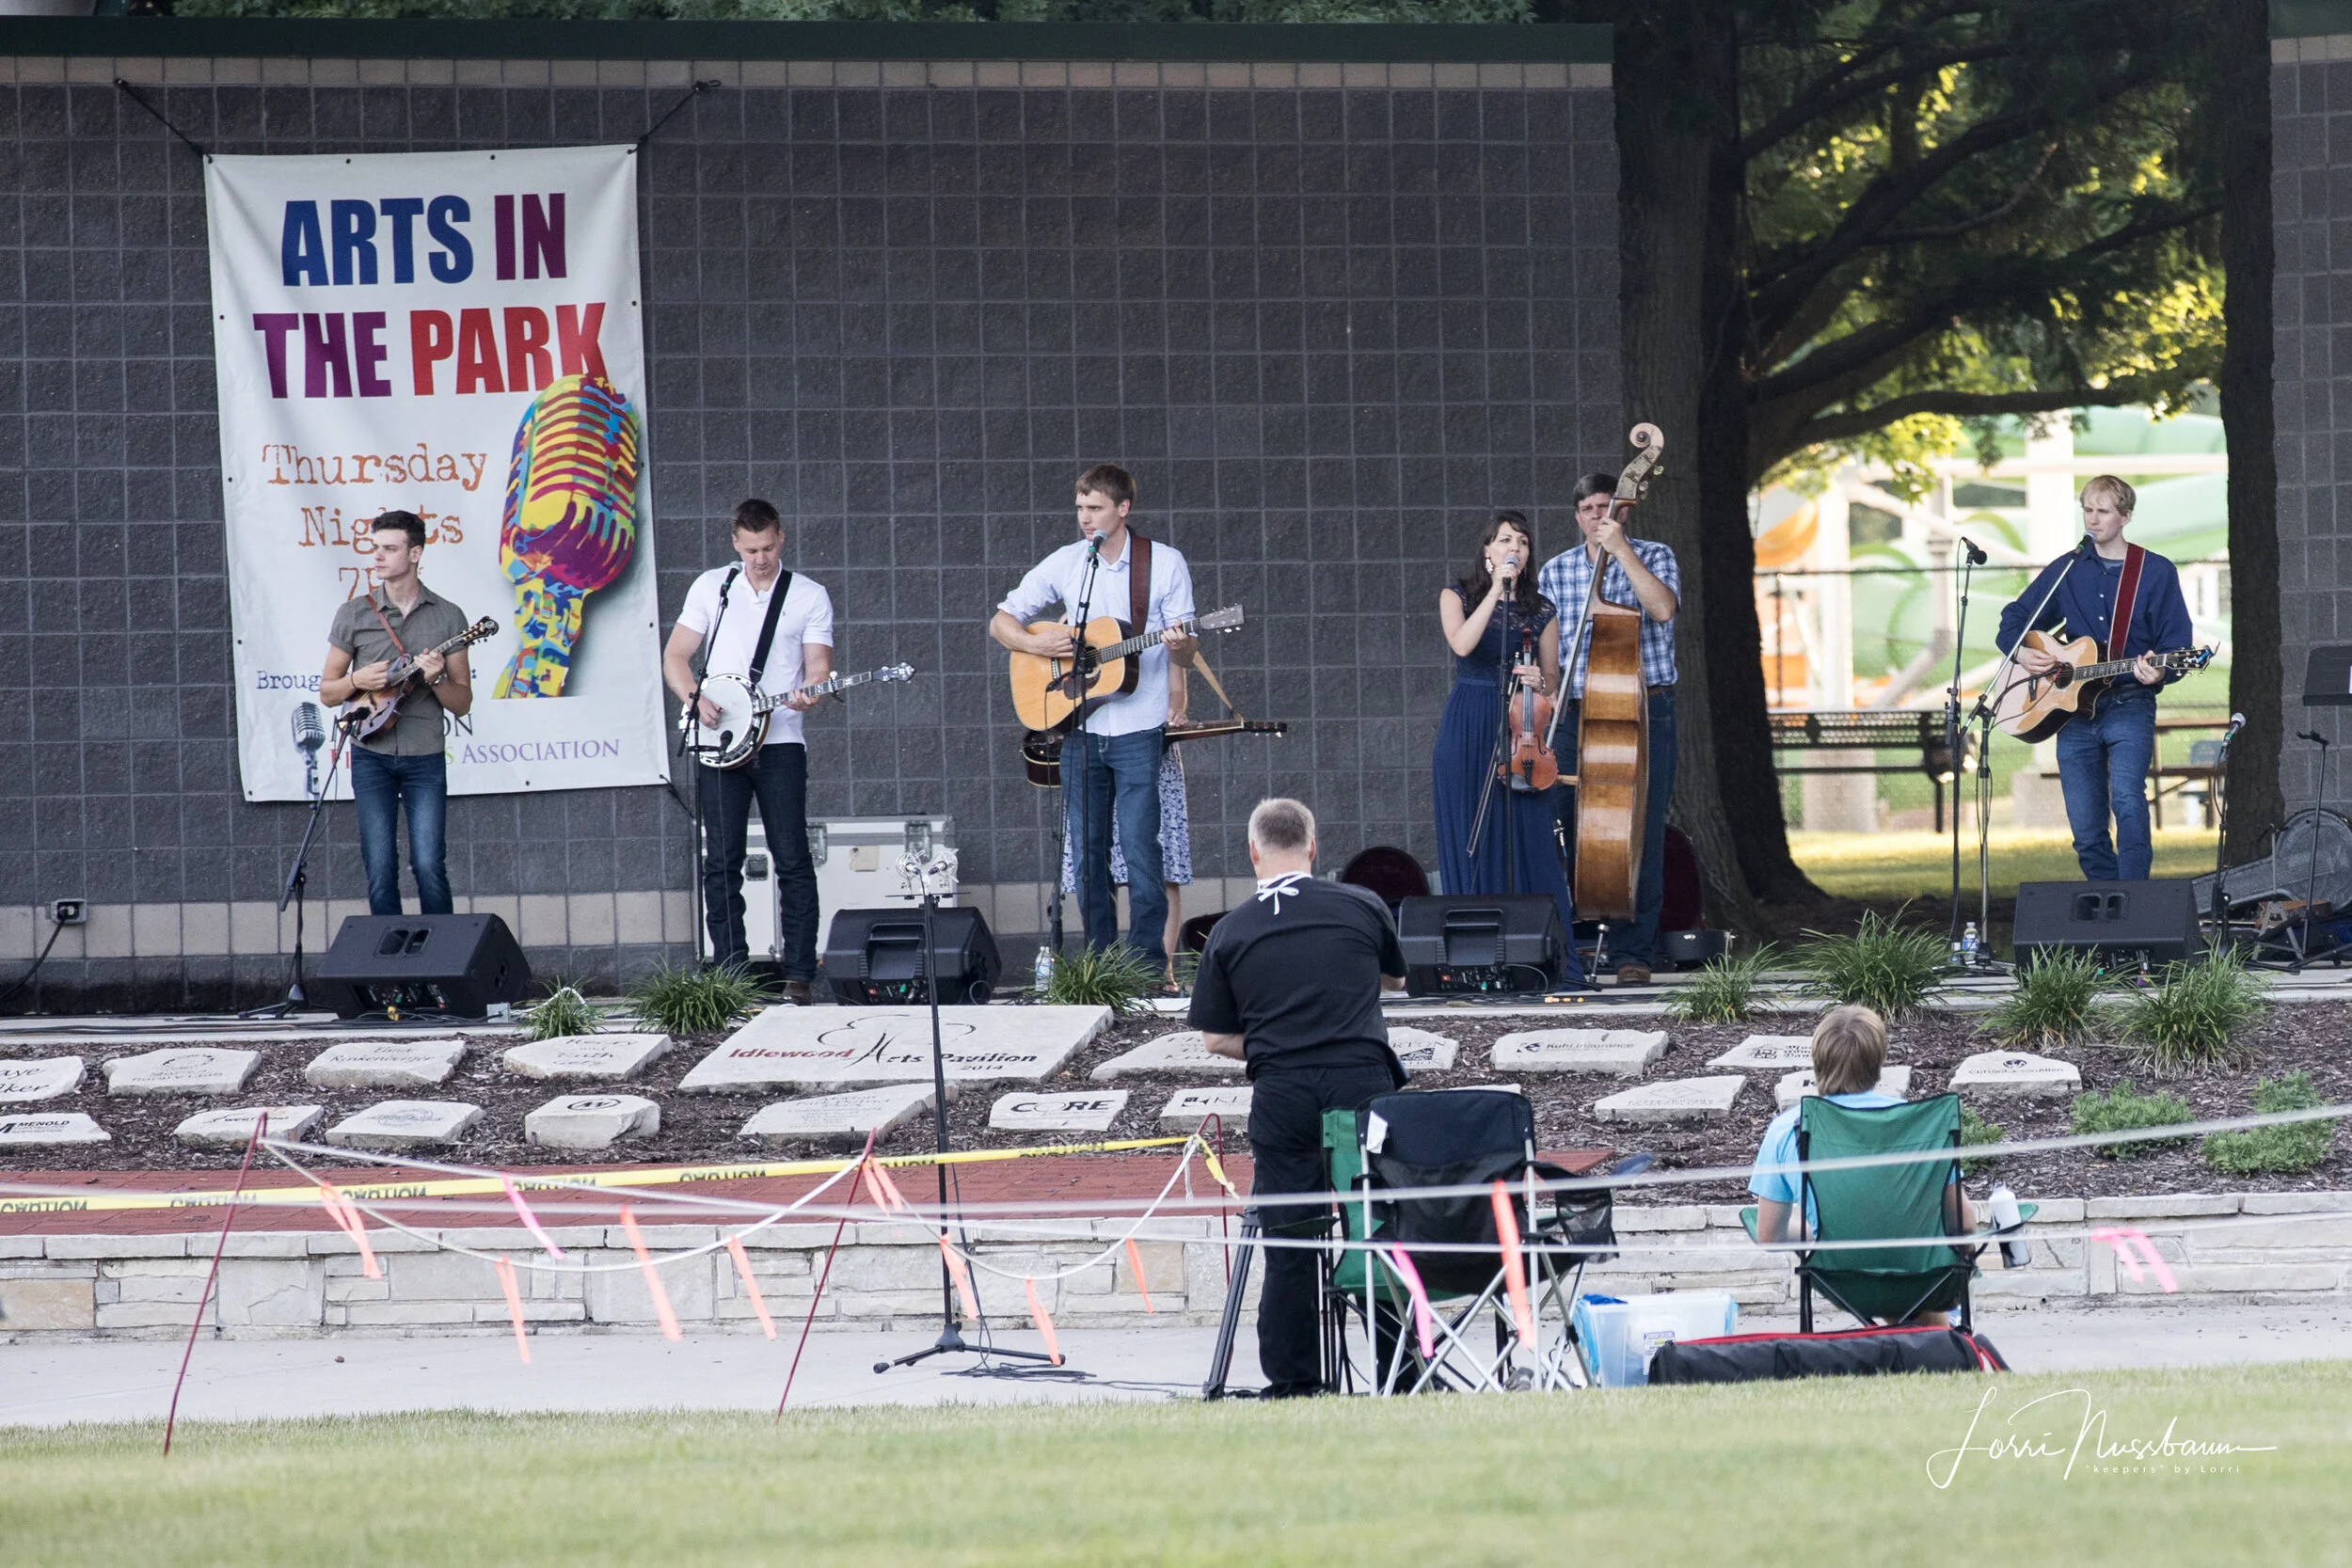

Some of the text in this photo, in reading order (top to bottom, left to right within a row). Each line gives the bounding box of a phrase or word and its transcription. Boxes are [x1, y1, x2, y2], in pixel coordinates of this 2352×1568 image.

[282, 193, 567, 286] ARTS IN
[252, 302, 610, 399] THE PARK
[262, 444, 487, 491] Thursday
[298, 504, 464, 555] Nigts
[462, 739, 620, 766] ASSOCIATION
[728, 1048, 854, 1059] Idlewood
[940, 1053, 1038, 1063] Pavilion
[1010, 1100, 1114, 1113] CORE
